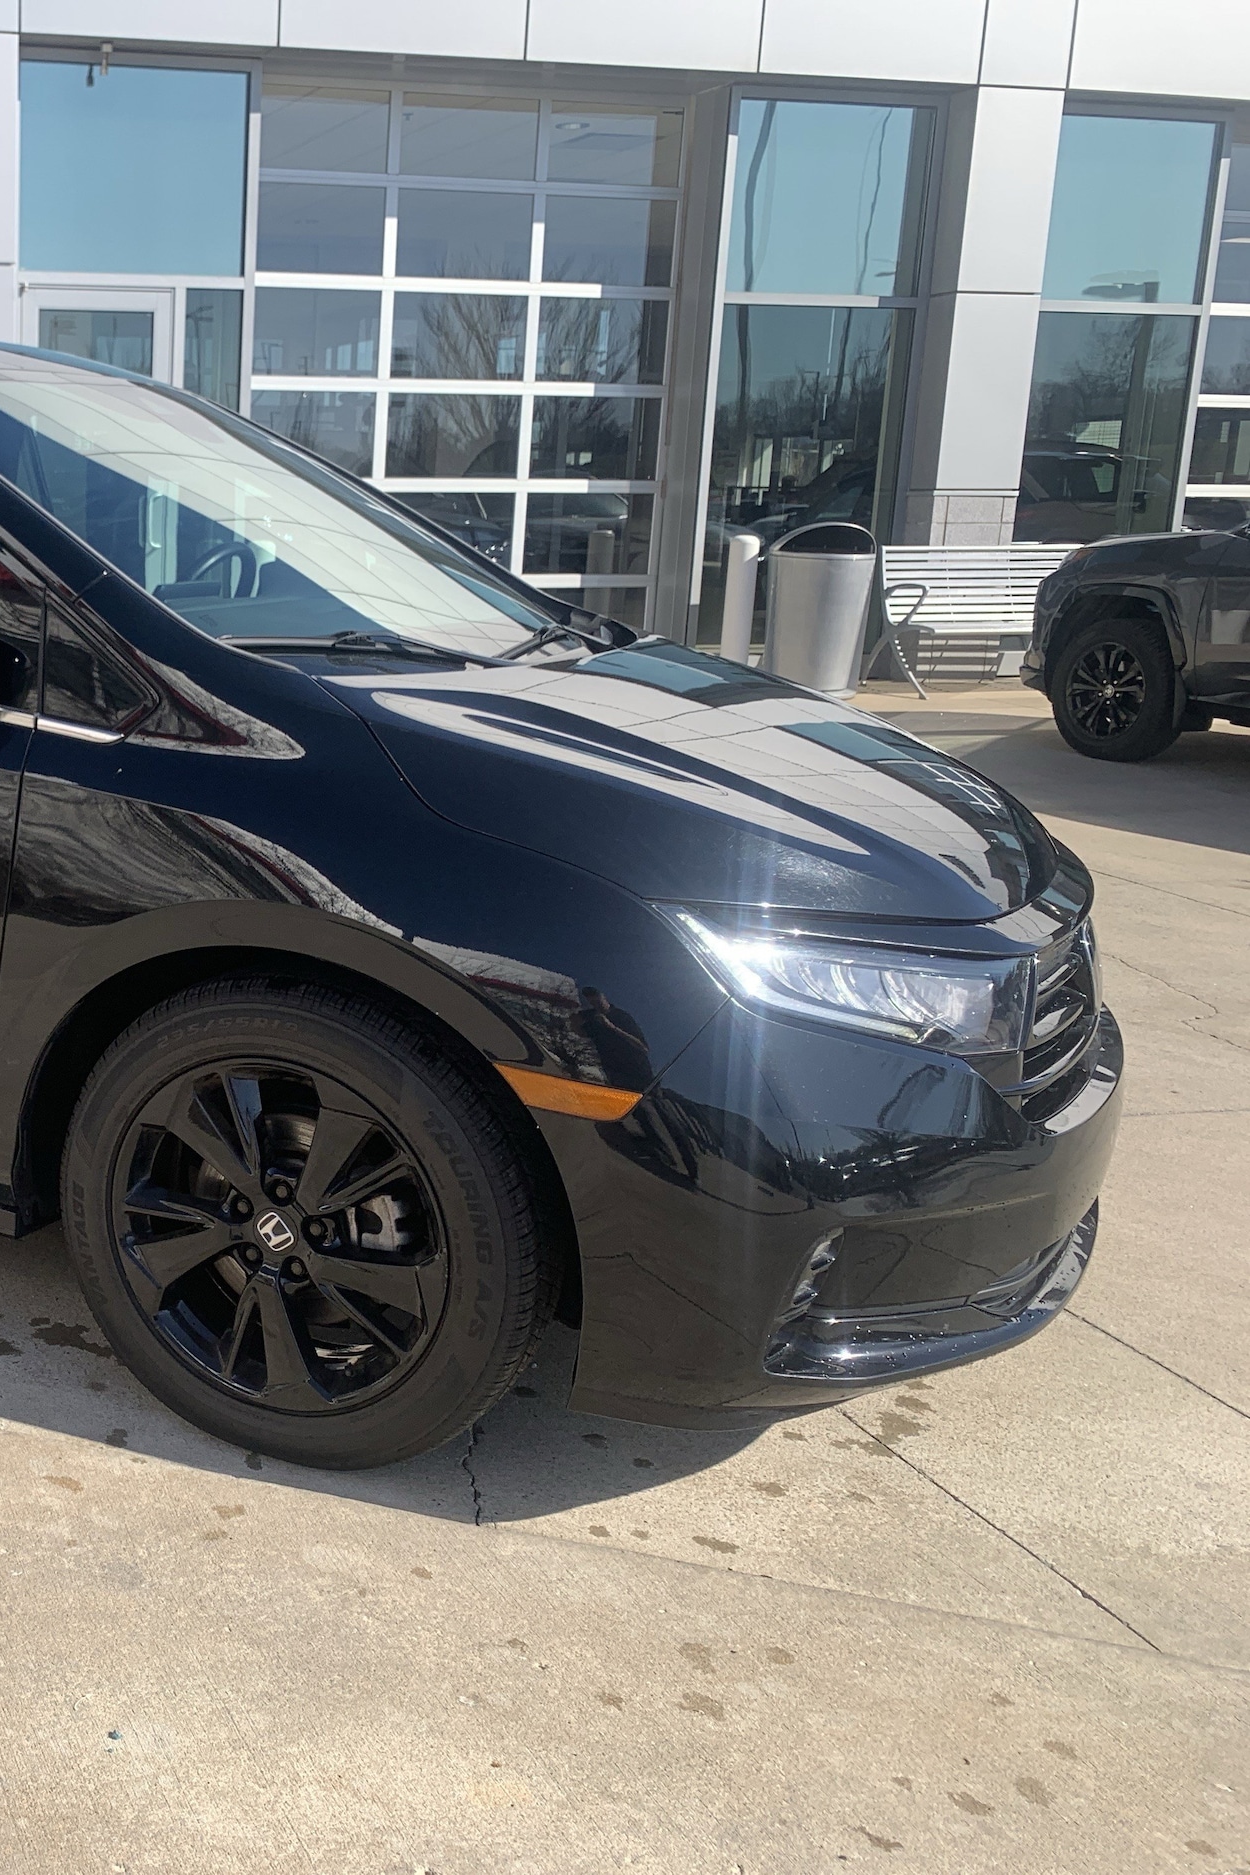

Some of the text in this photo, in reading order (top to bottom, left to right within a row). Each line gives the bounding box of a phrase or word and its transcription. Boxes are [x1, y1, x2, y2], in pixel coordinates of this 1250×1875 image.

[157, 1016, 298, 1048] 235/55R19
[72, 1178, 108, 1306] VANTAGE
[422, 1110, 494, 1341] TOURING A/S
